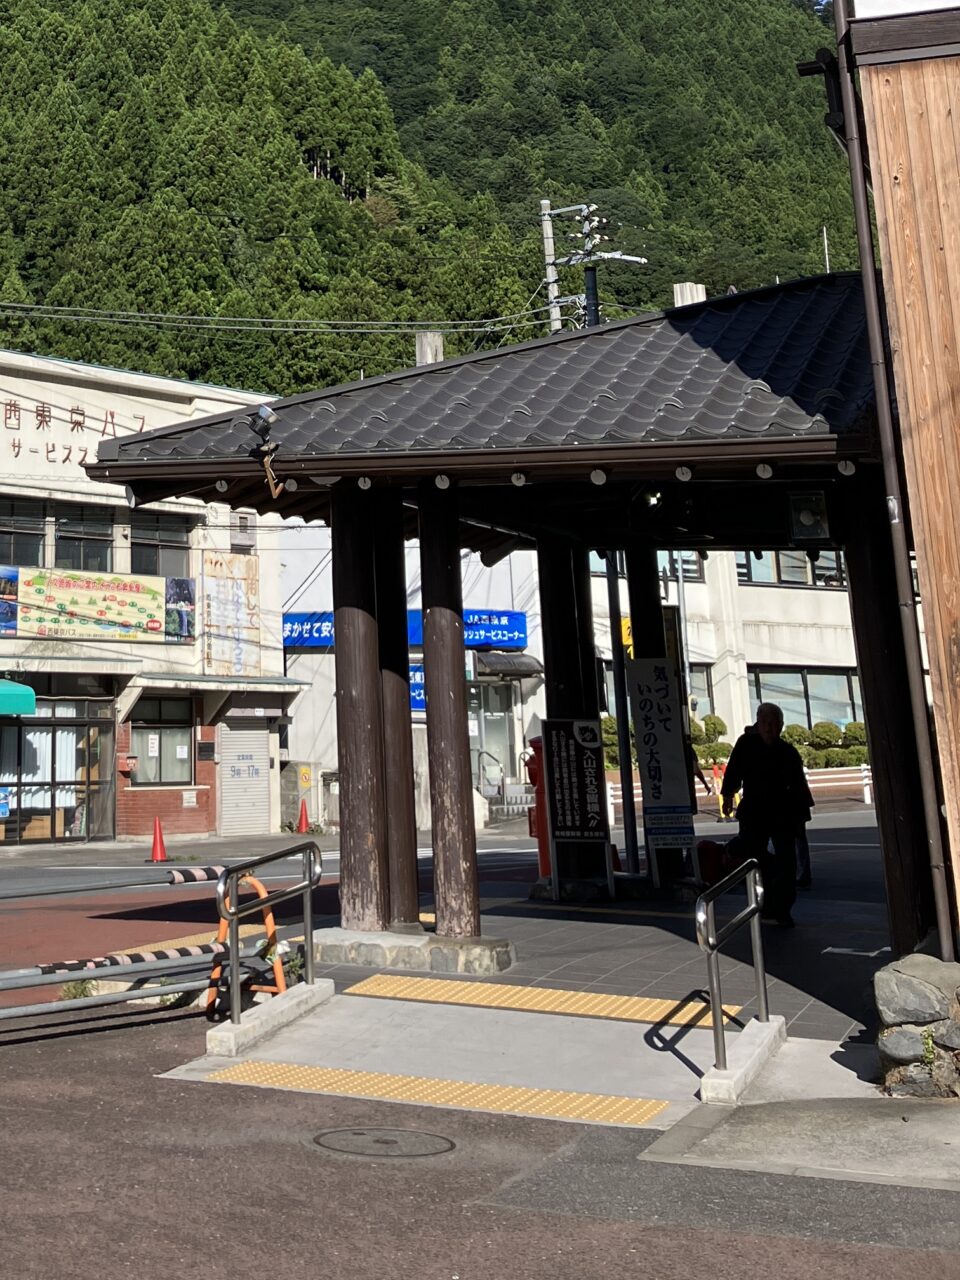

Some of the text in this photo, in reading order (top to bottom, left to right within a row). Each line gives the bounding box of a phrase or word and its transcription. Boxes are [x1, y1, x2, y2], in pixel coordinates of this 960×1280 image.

[11, 437, 98, 466] サービスス
[283, 621, 335, 638] まかせて安
[653, 665, 672, 733] 気づいて
[637, 683, 662, 800] いのちの大切さ
